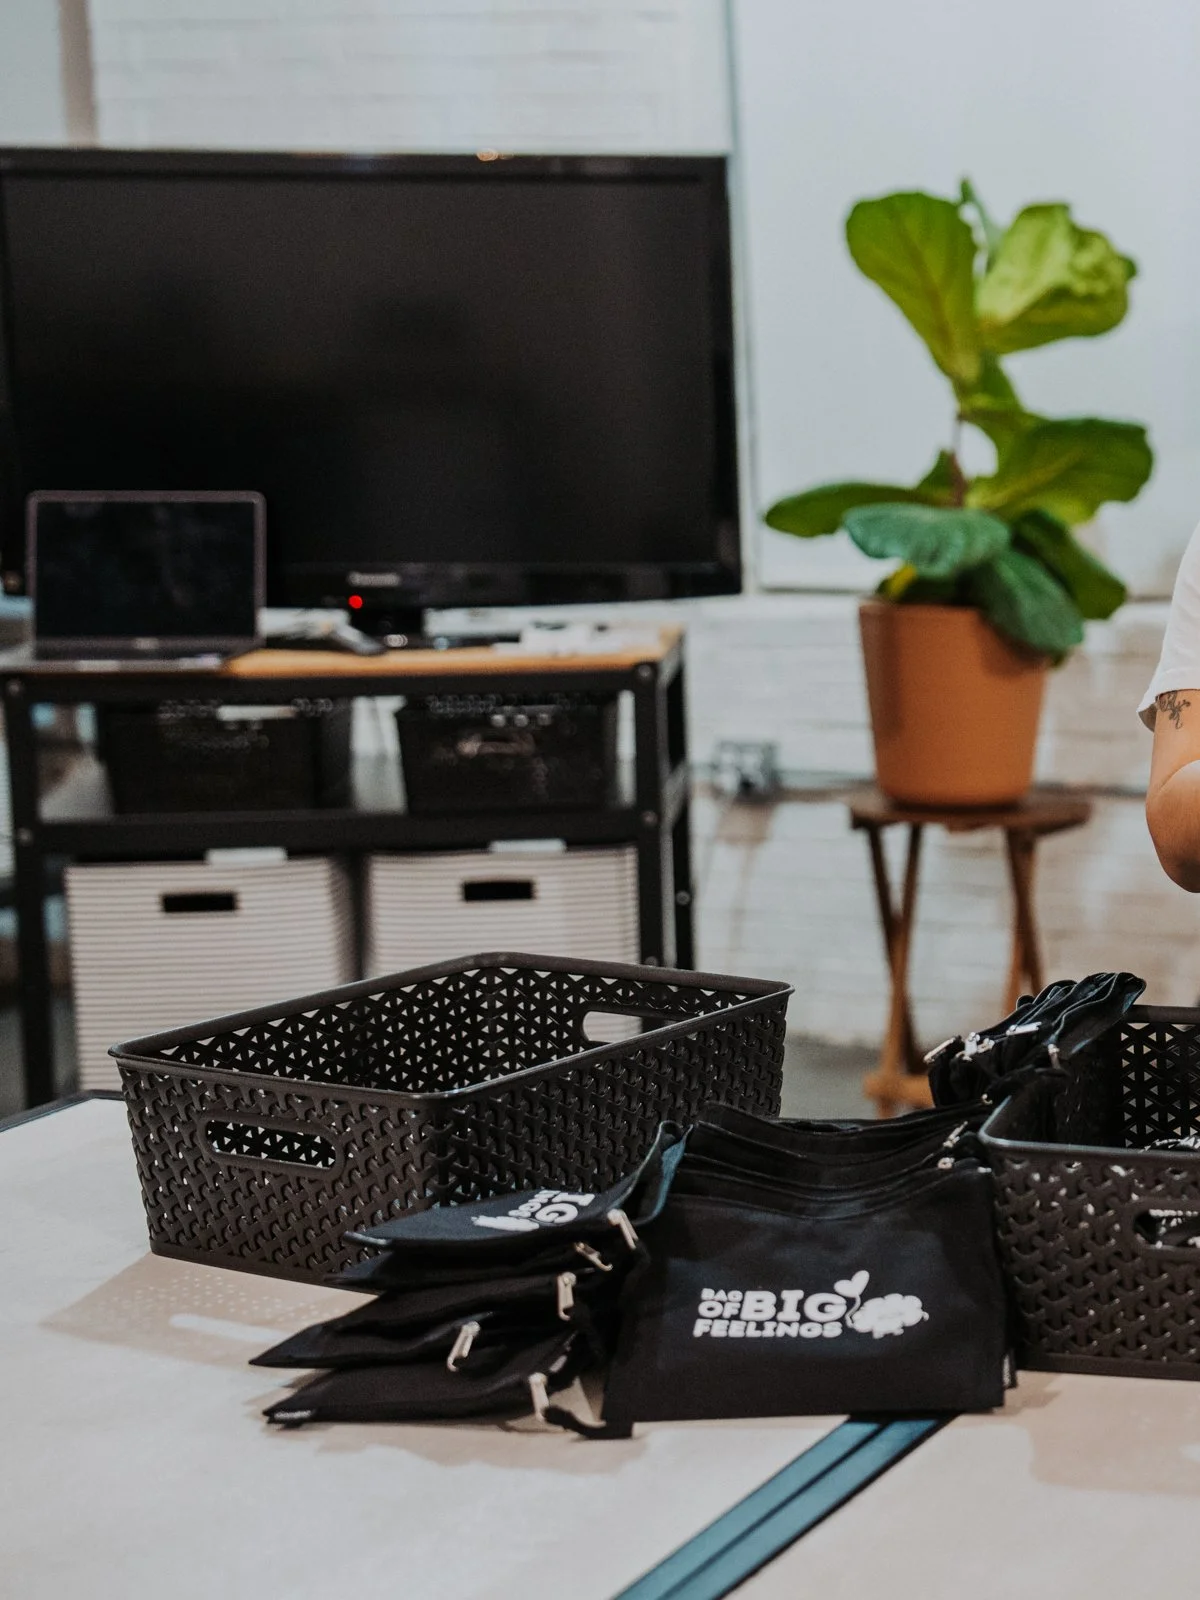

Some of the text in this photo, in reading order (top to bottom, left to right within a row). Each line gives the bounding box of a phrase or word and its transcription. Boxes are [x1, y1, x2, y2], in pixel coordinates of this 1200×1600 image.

[534, 1192, 596, 1224] IG
[700, 1288, 743, 1302] BAG
[698, 1300, 741, 1319] OF
[740, 1289, 848, 1322] BIG
[693, 1318, 843, 1338] FEELINGS
